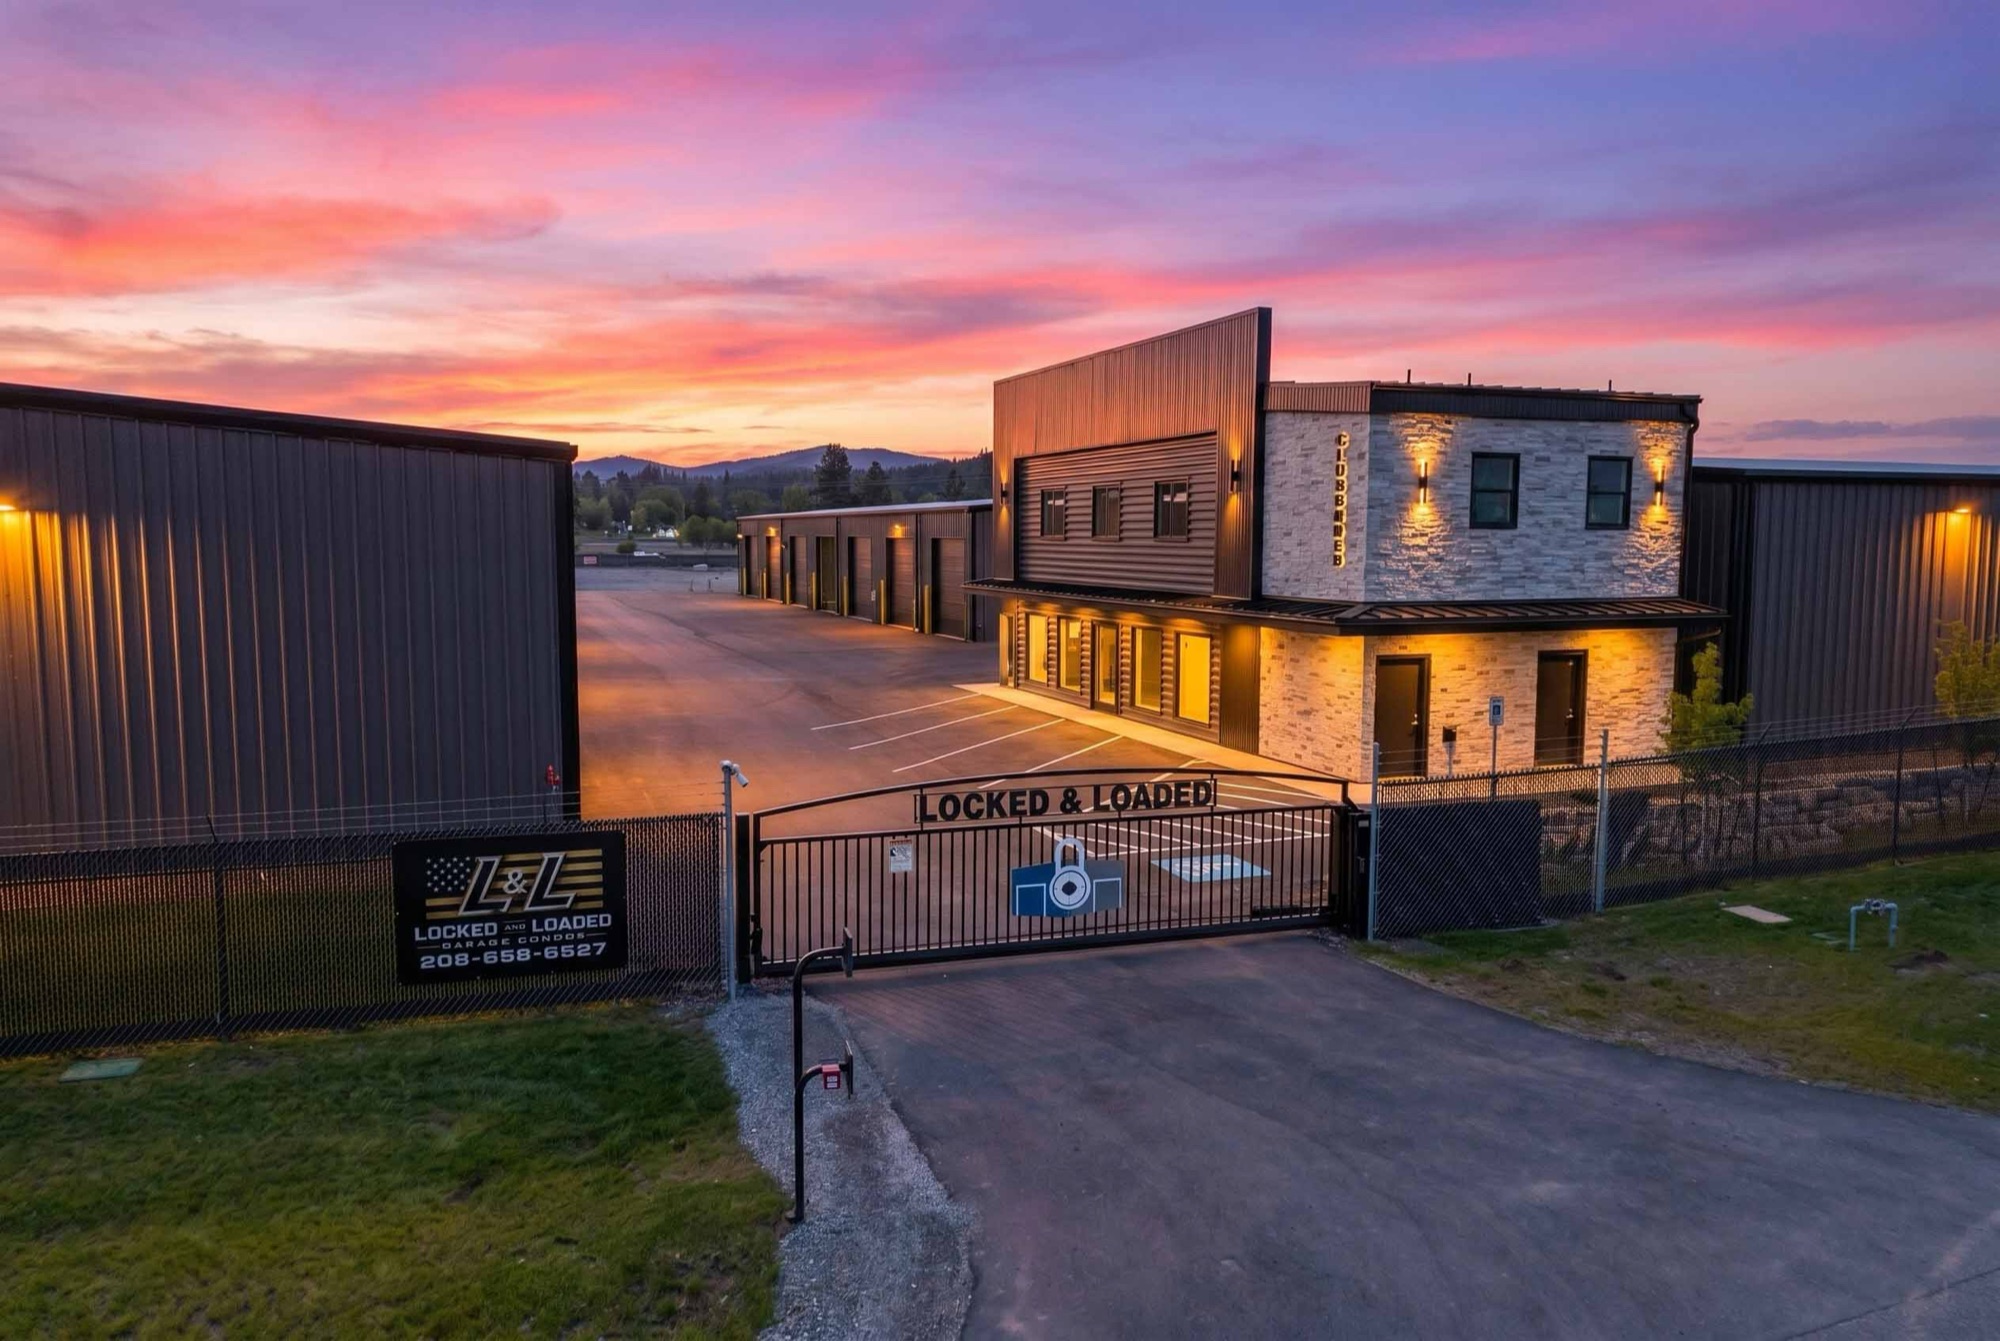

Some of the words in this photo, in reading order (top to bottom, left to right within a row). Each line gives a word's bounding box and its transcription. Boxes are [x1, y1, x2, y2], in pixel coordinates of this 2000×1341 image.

[919, 789, 1049, 822] LOCKED
[1059, 787, 1082, 814] &
[1093, 780, 1212, 812] LOADED
[458, 852, 576, 915] L&L
[414, 922, 498, 941] LOCKED
[504, 923, 526, 931] AND
[532, 913, 612, 932] LOADED
[518, 931, 585, 944] CONDOS
[420, 942, 606, 969] 208-658-6527
